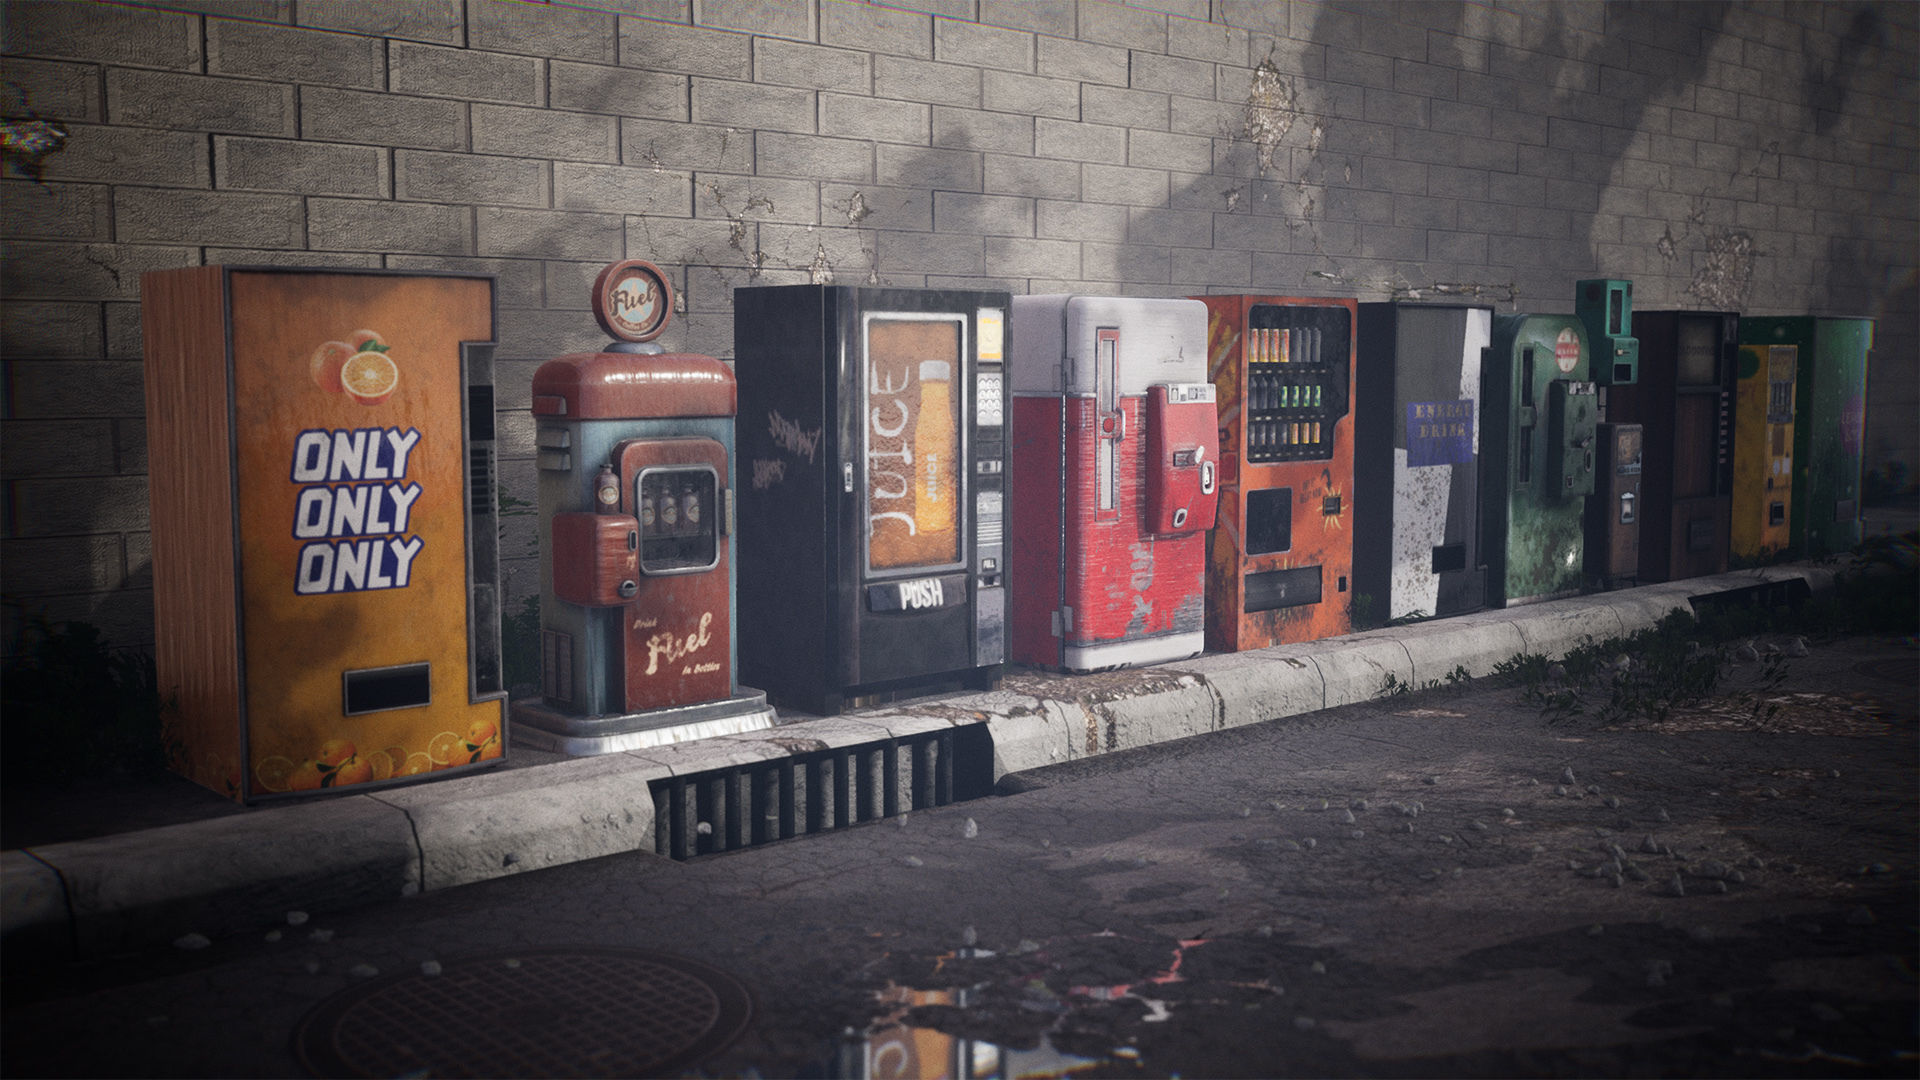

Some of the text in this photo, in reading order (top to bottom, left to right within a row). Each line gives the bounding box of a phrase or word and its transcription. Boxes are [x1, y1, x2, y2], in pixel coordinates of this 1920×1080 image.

[610, 280, 656, 317] Fuel
[291, 427, 421, 483] ONLY
[869, 360, 916, 536] JUICE
[927, 453, 937, 503] JUICE
[293, 482, 423, 540] ONLY
[295, 536, 424, 595] ONLY
[900, 578, 944, 610] PUSH
[645, 612, 712, 675] Fuel
